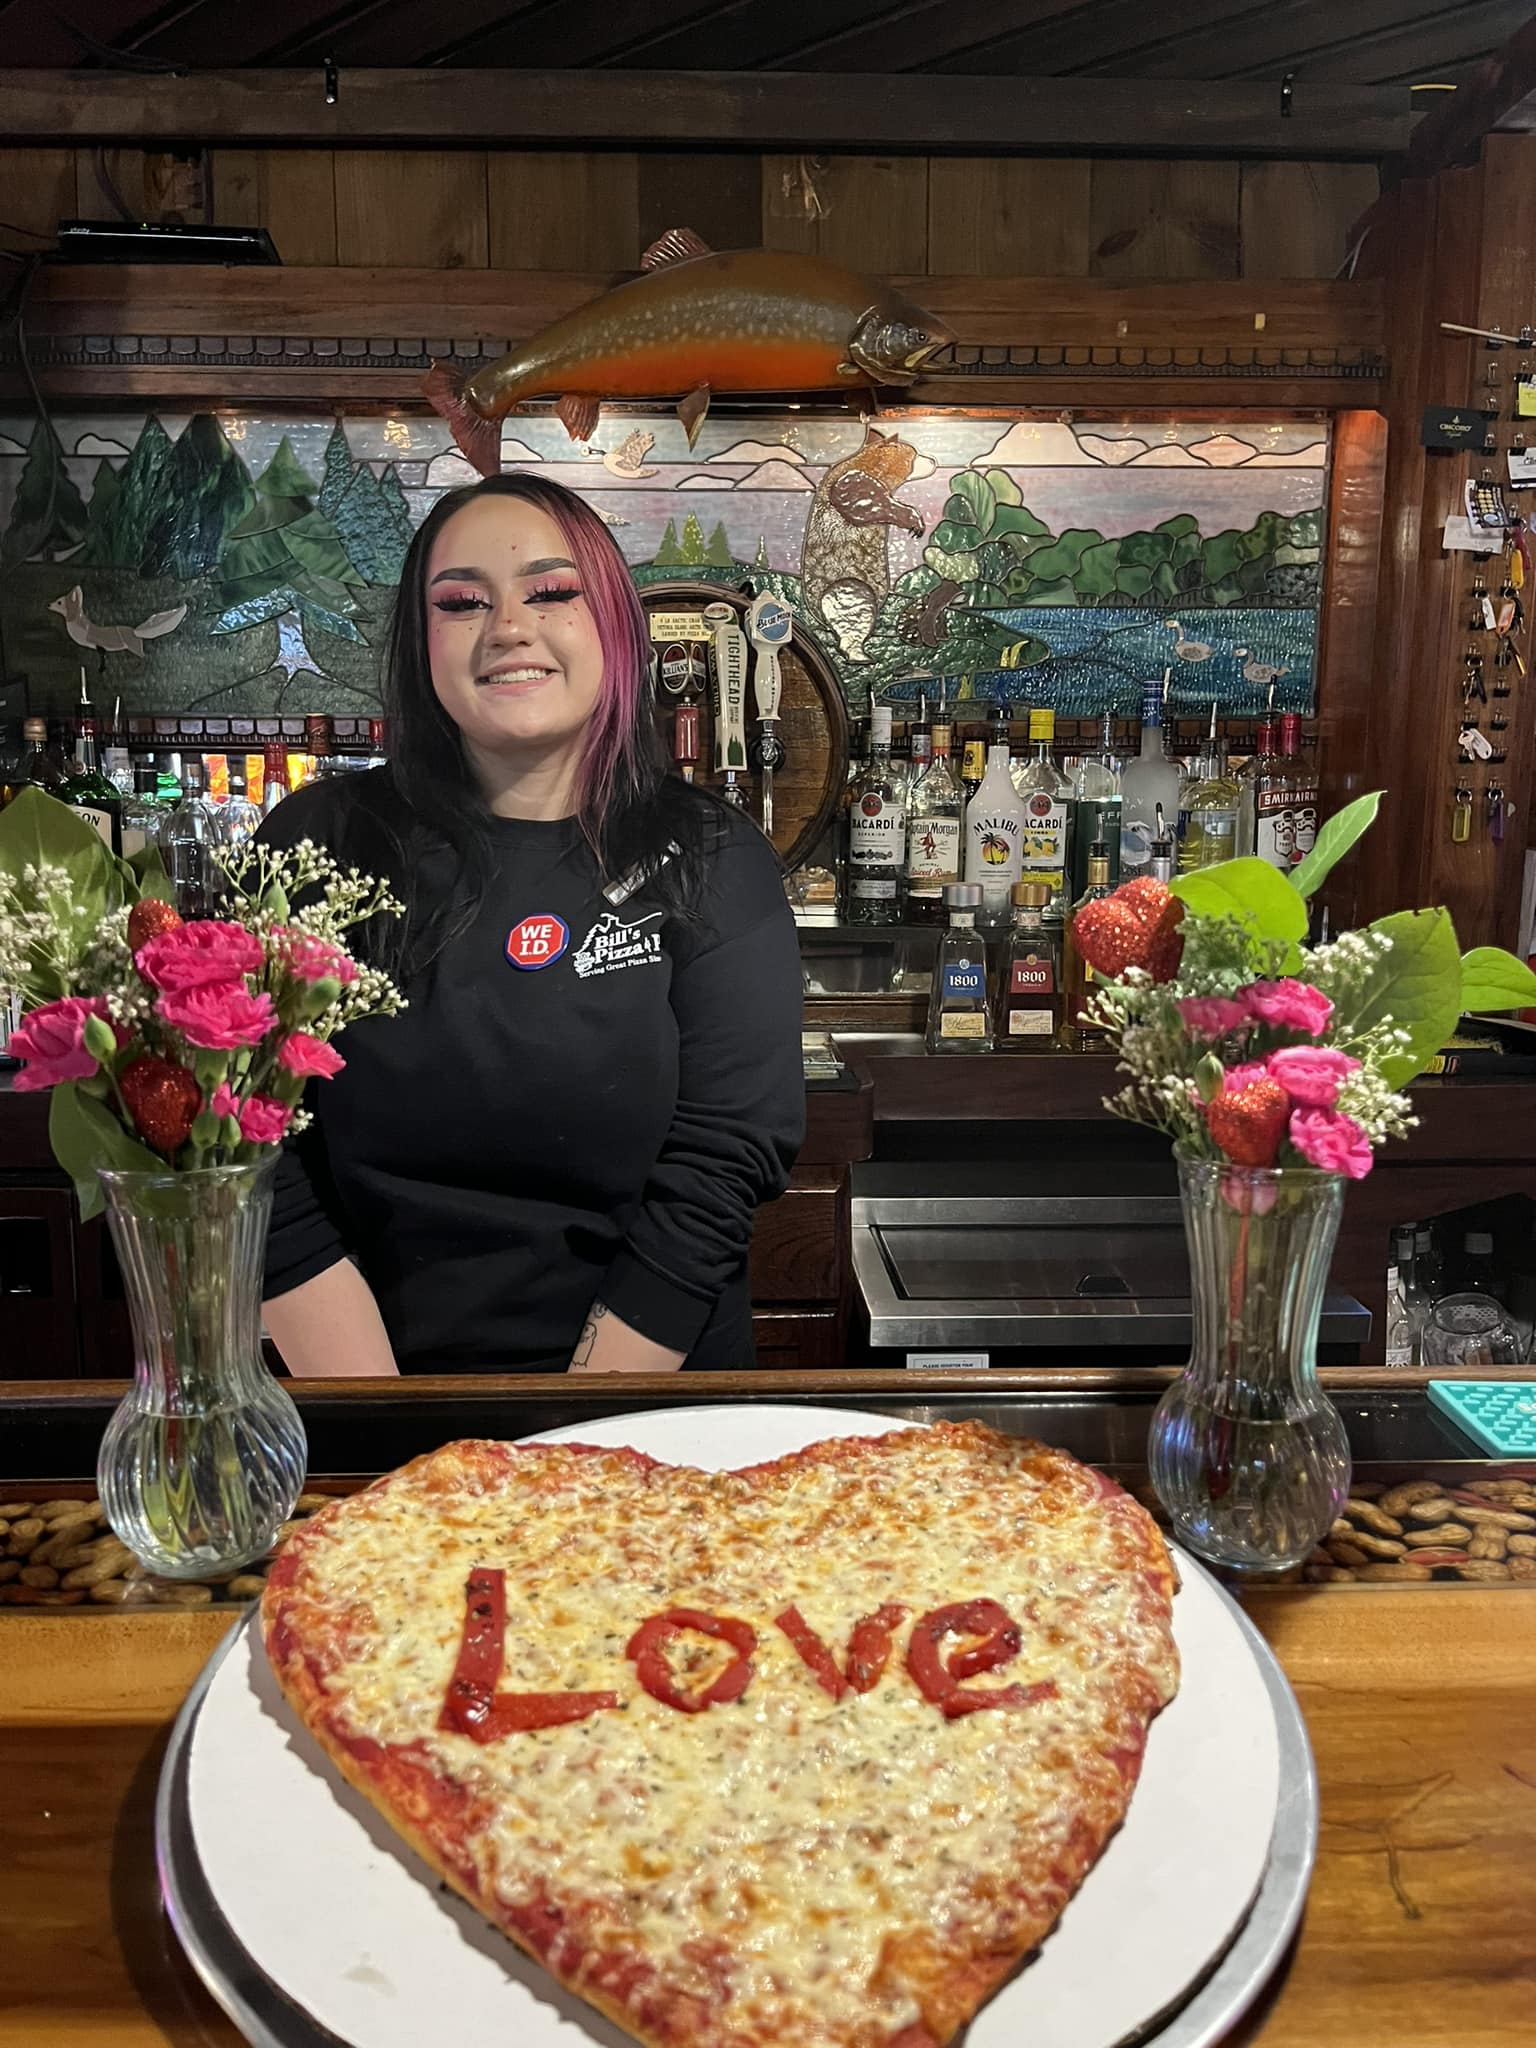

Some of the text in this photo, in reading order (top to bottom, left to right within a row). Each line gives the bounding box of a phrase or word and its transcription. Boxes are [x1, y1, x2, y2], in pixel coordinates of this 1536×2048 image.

[727, 634, 740, 704] TIGHTHEAD
[851, 816, 895, 830] BACARDÍ
[974, 818, 1020, 836] MALIBU
[1025, 816, 1062, 829] ACARDÍ
[521, 924, 553, 940] WE
[594, 928, 641, 950] Bill's
[519, 939, 550, 956] I.D.
[594, 943, 645, 964] Pizza
[579, 966, 605, 978] Serving
[606, 962, 626, 971] Great
[627, 958, 648, 967] Pizza
[949, 975, 978, 987] 1800
[1017, 971, 1047, 983] 1800
[437, 1567, 1062, 1746] Love
